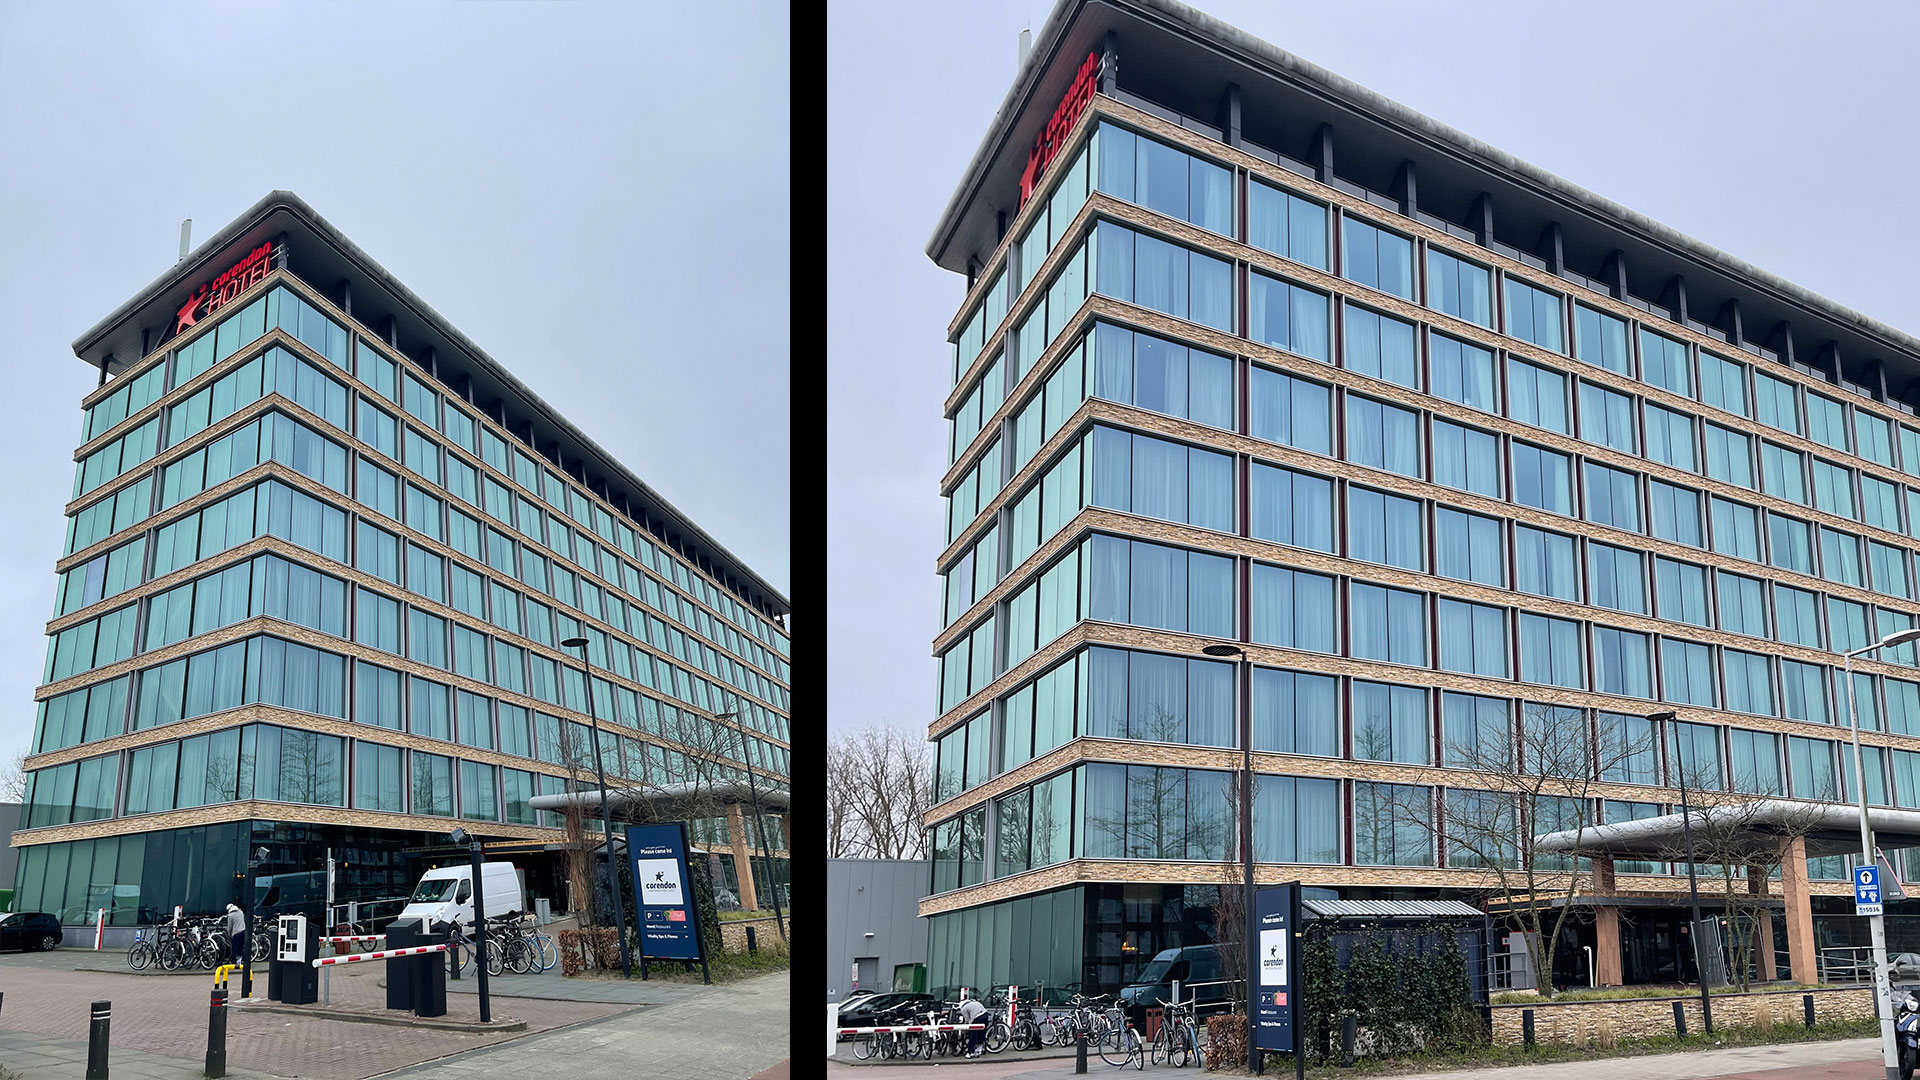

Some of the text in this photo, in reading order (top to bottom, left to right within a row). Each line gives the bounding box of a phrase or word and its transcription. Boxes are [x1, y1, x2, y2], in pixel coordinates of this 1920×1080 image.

[1046, 51, 1098, 141] corendon
[207, 255, 274, 316] HOTEL
[211, 241, 272, 291] corendon
[645, 881, 677, 890] corendon
[1263, 957, 1284, 967] corendon
